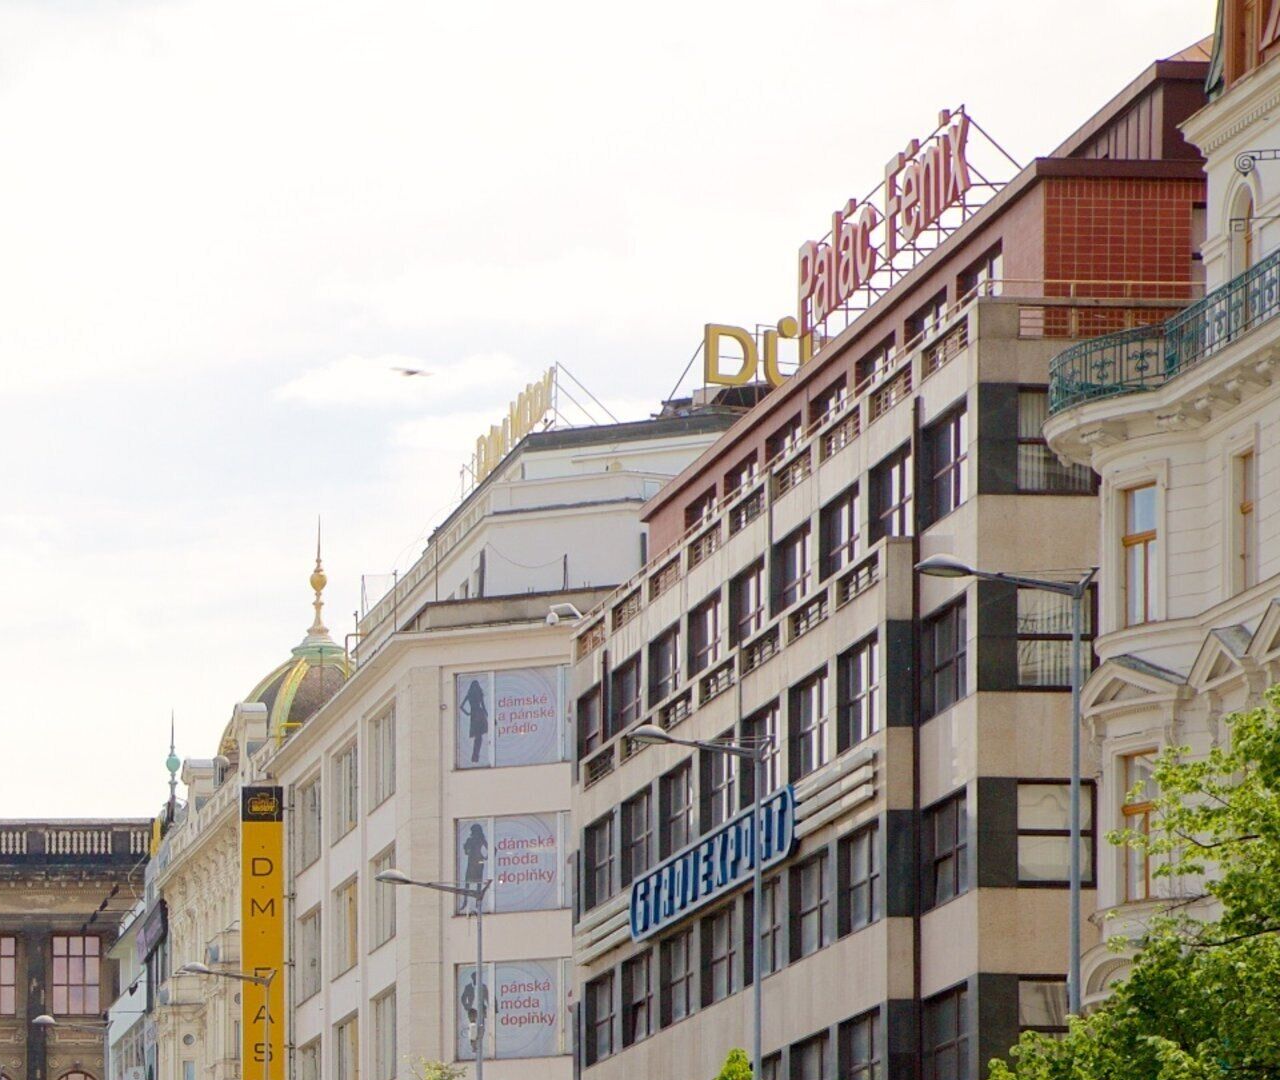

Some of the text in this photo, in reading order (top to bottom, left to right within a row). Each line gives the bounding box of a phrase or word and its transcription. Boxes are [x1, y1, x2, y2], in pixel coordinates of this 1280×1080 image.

[797, 108, 971, 337] Palác Fénix
[498, 693, 548, 708] dámské
[498, 706, 555, 722] a pánské
[498, 722, 538, 738] prádlo
[498, 834, 555, 850] dámská
[498, 867, 554, 884] doplňky
[500, 978, 551, 996] pánská
[500, 995, 540, 1009] móda
[500, 1011, 555, 1027] doplňky
